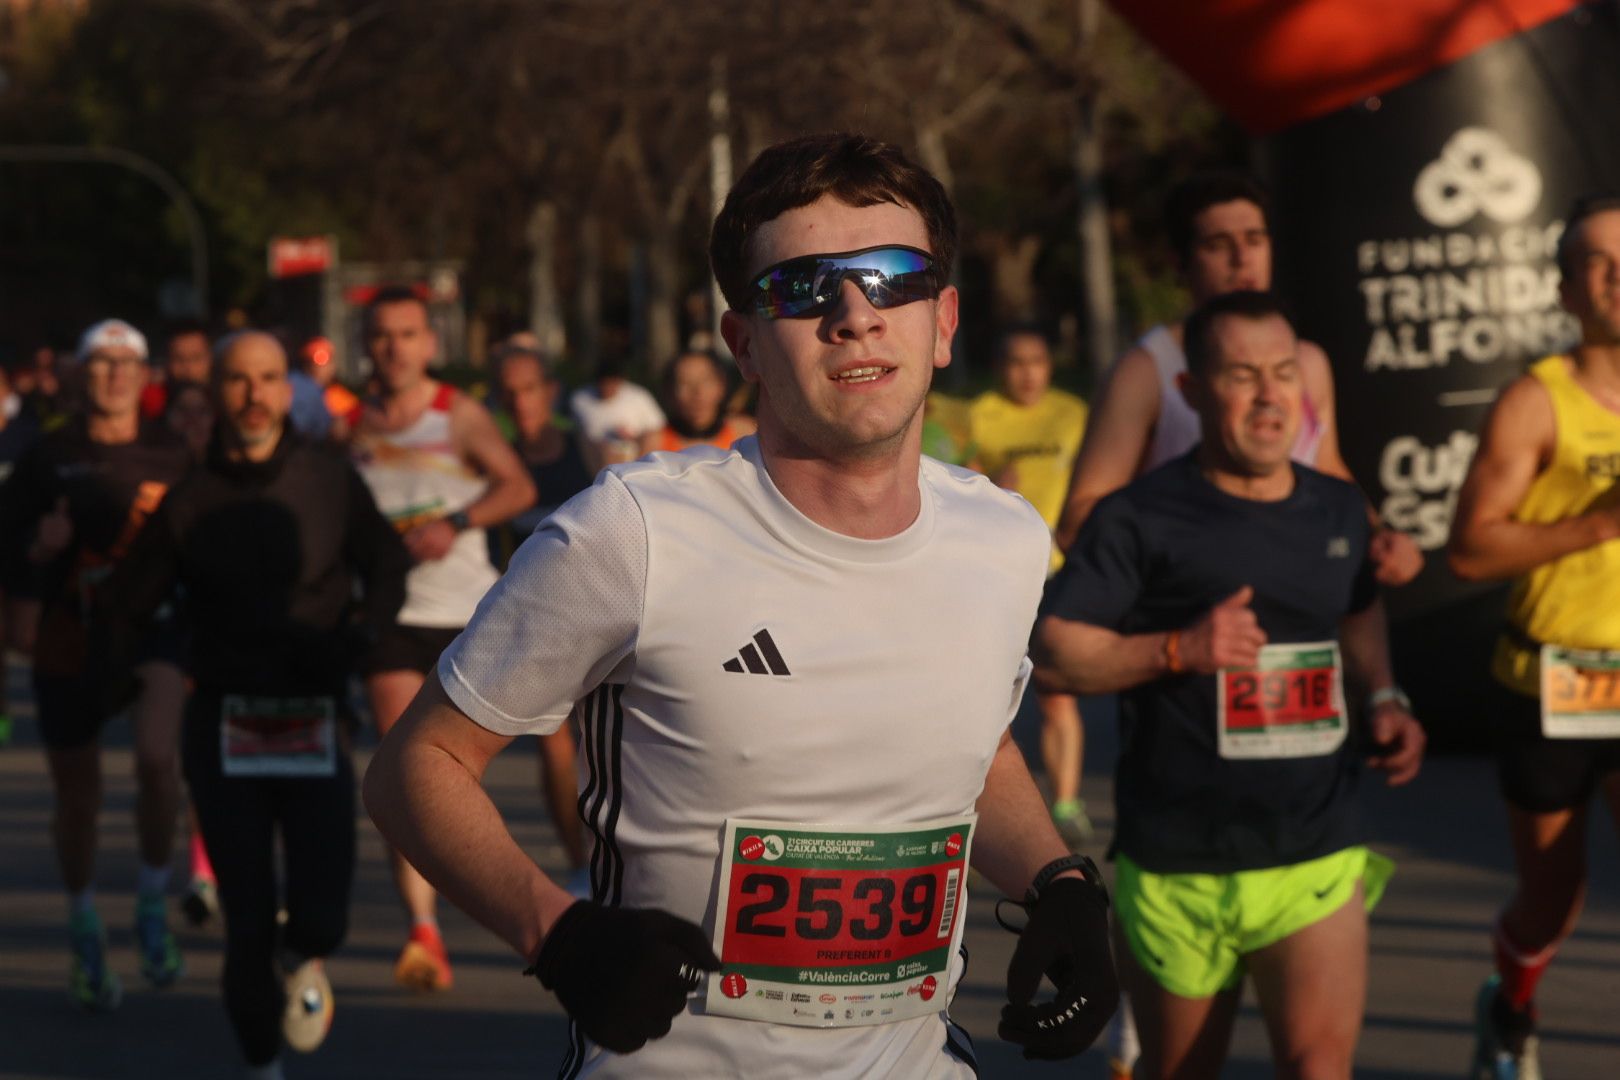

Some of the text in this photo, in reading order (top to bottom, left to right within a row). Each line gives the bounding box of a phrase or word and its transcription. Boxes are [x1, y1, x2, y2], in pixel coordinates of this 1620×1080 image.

[786, 843, 863, 856] CAIXA POPULAR
[735, 873, 937, 940] 2539
[816, 949, 881, 960] PREFERENT
[799, 970, 890, 983] #ValènciaCorre
